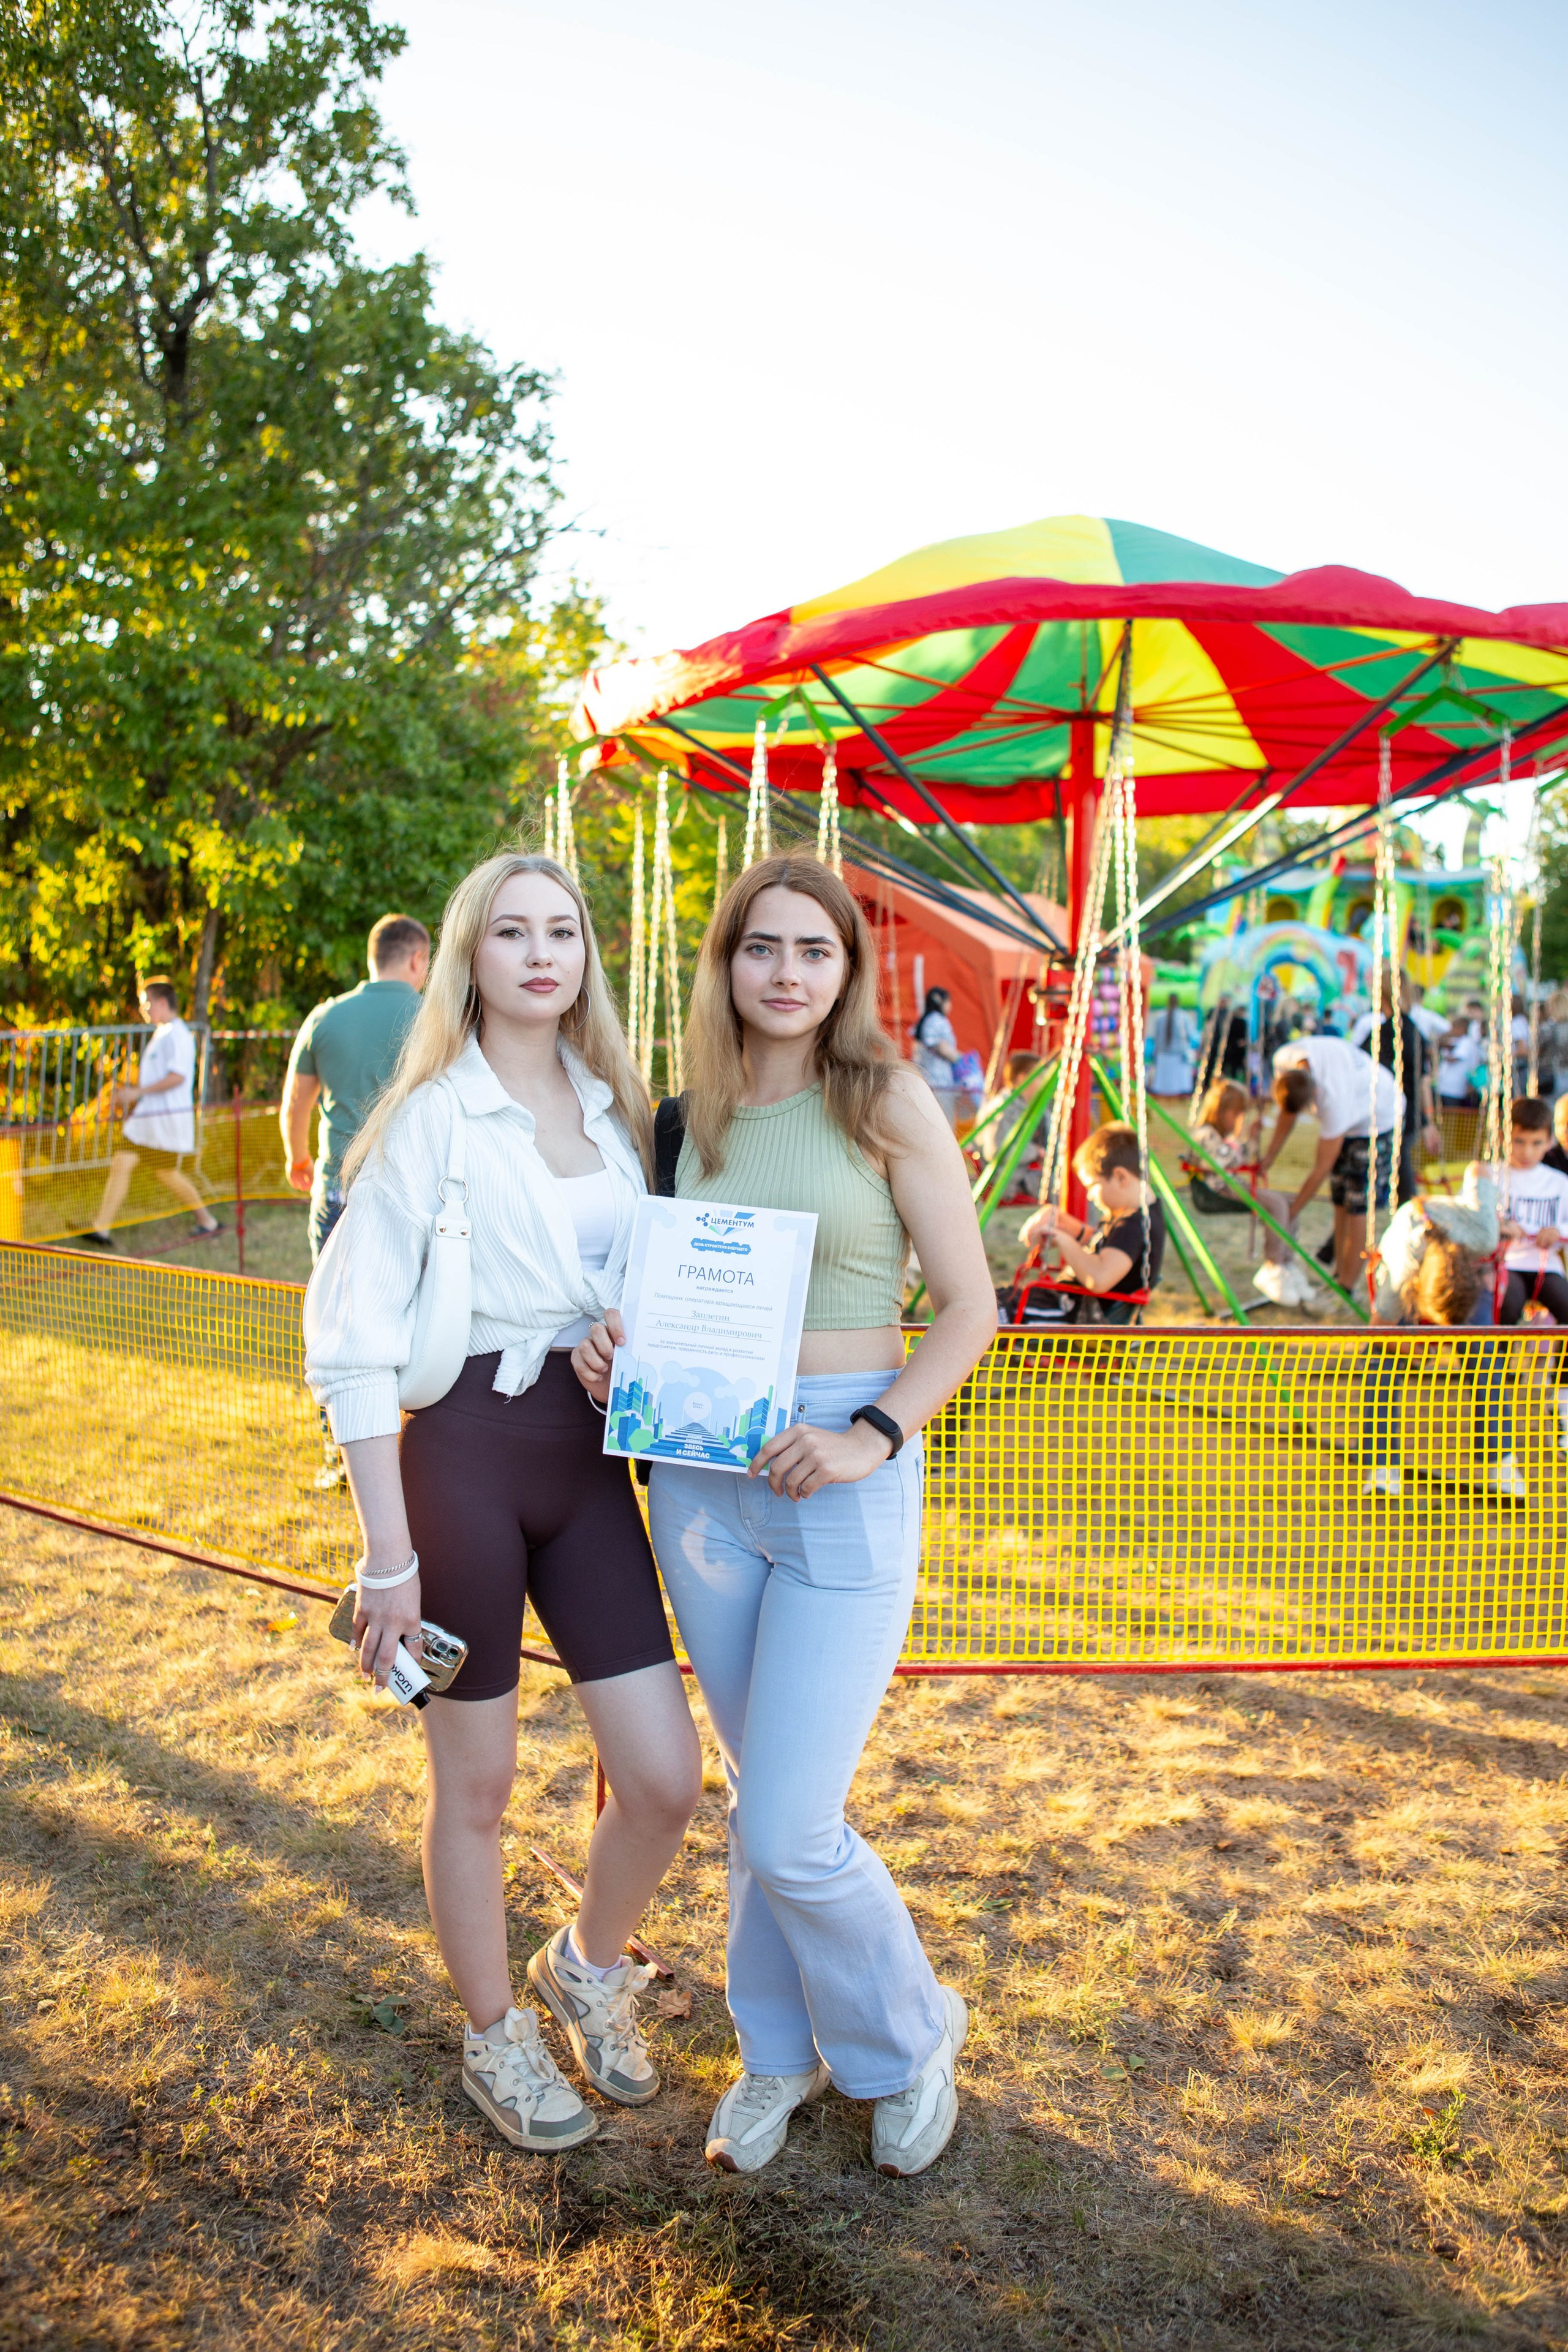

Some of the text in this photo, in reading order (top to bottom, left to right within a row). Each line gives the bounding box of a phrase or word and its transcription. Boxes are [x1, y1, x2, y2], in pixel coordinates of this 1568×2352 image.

[710, 1218, 754, 1227] ЦЕМЕНТУМ
[678, 1264, 754, 1286] ГРАМОТА
[654, 1292, 683, 1301] Помощник
[715, 1300, 755, 1309] вращающихся
[692, 1310, 729, 1321] Заплетин
[655, 1319, 762, 1338] Александр Владимирович
[682, 1449, 710, 1458] СЕЙЧАС
